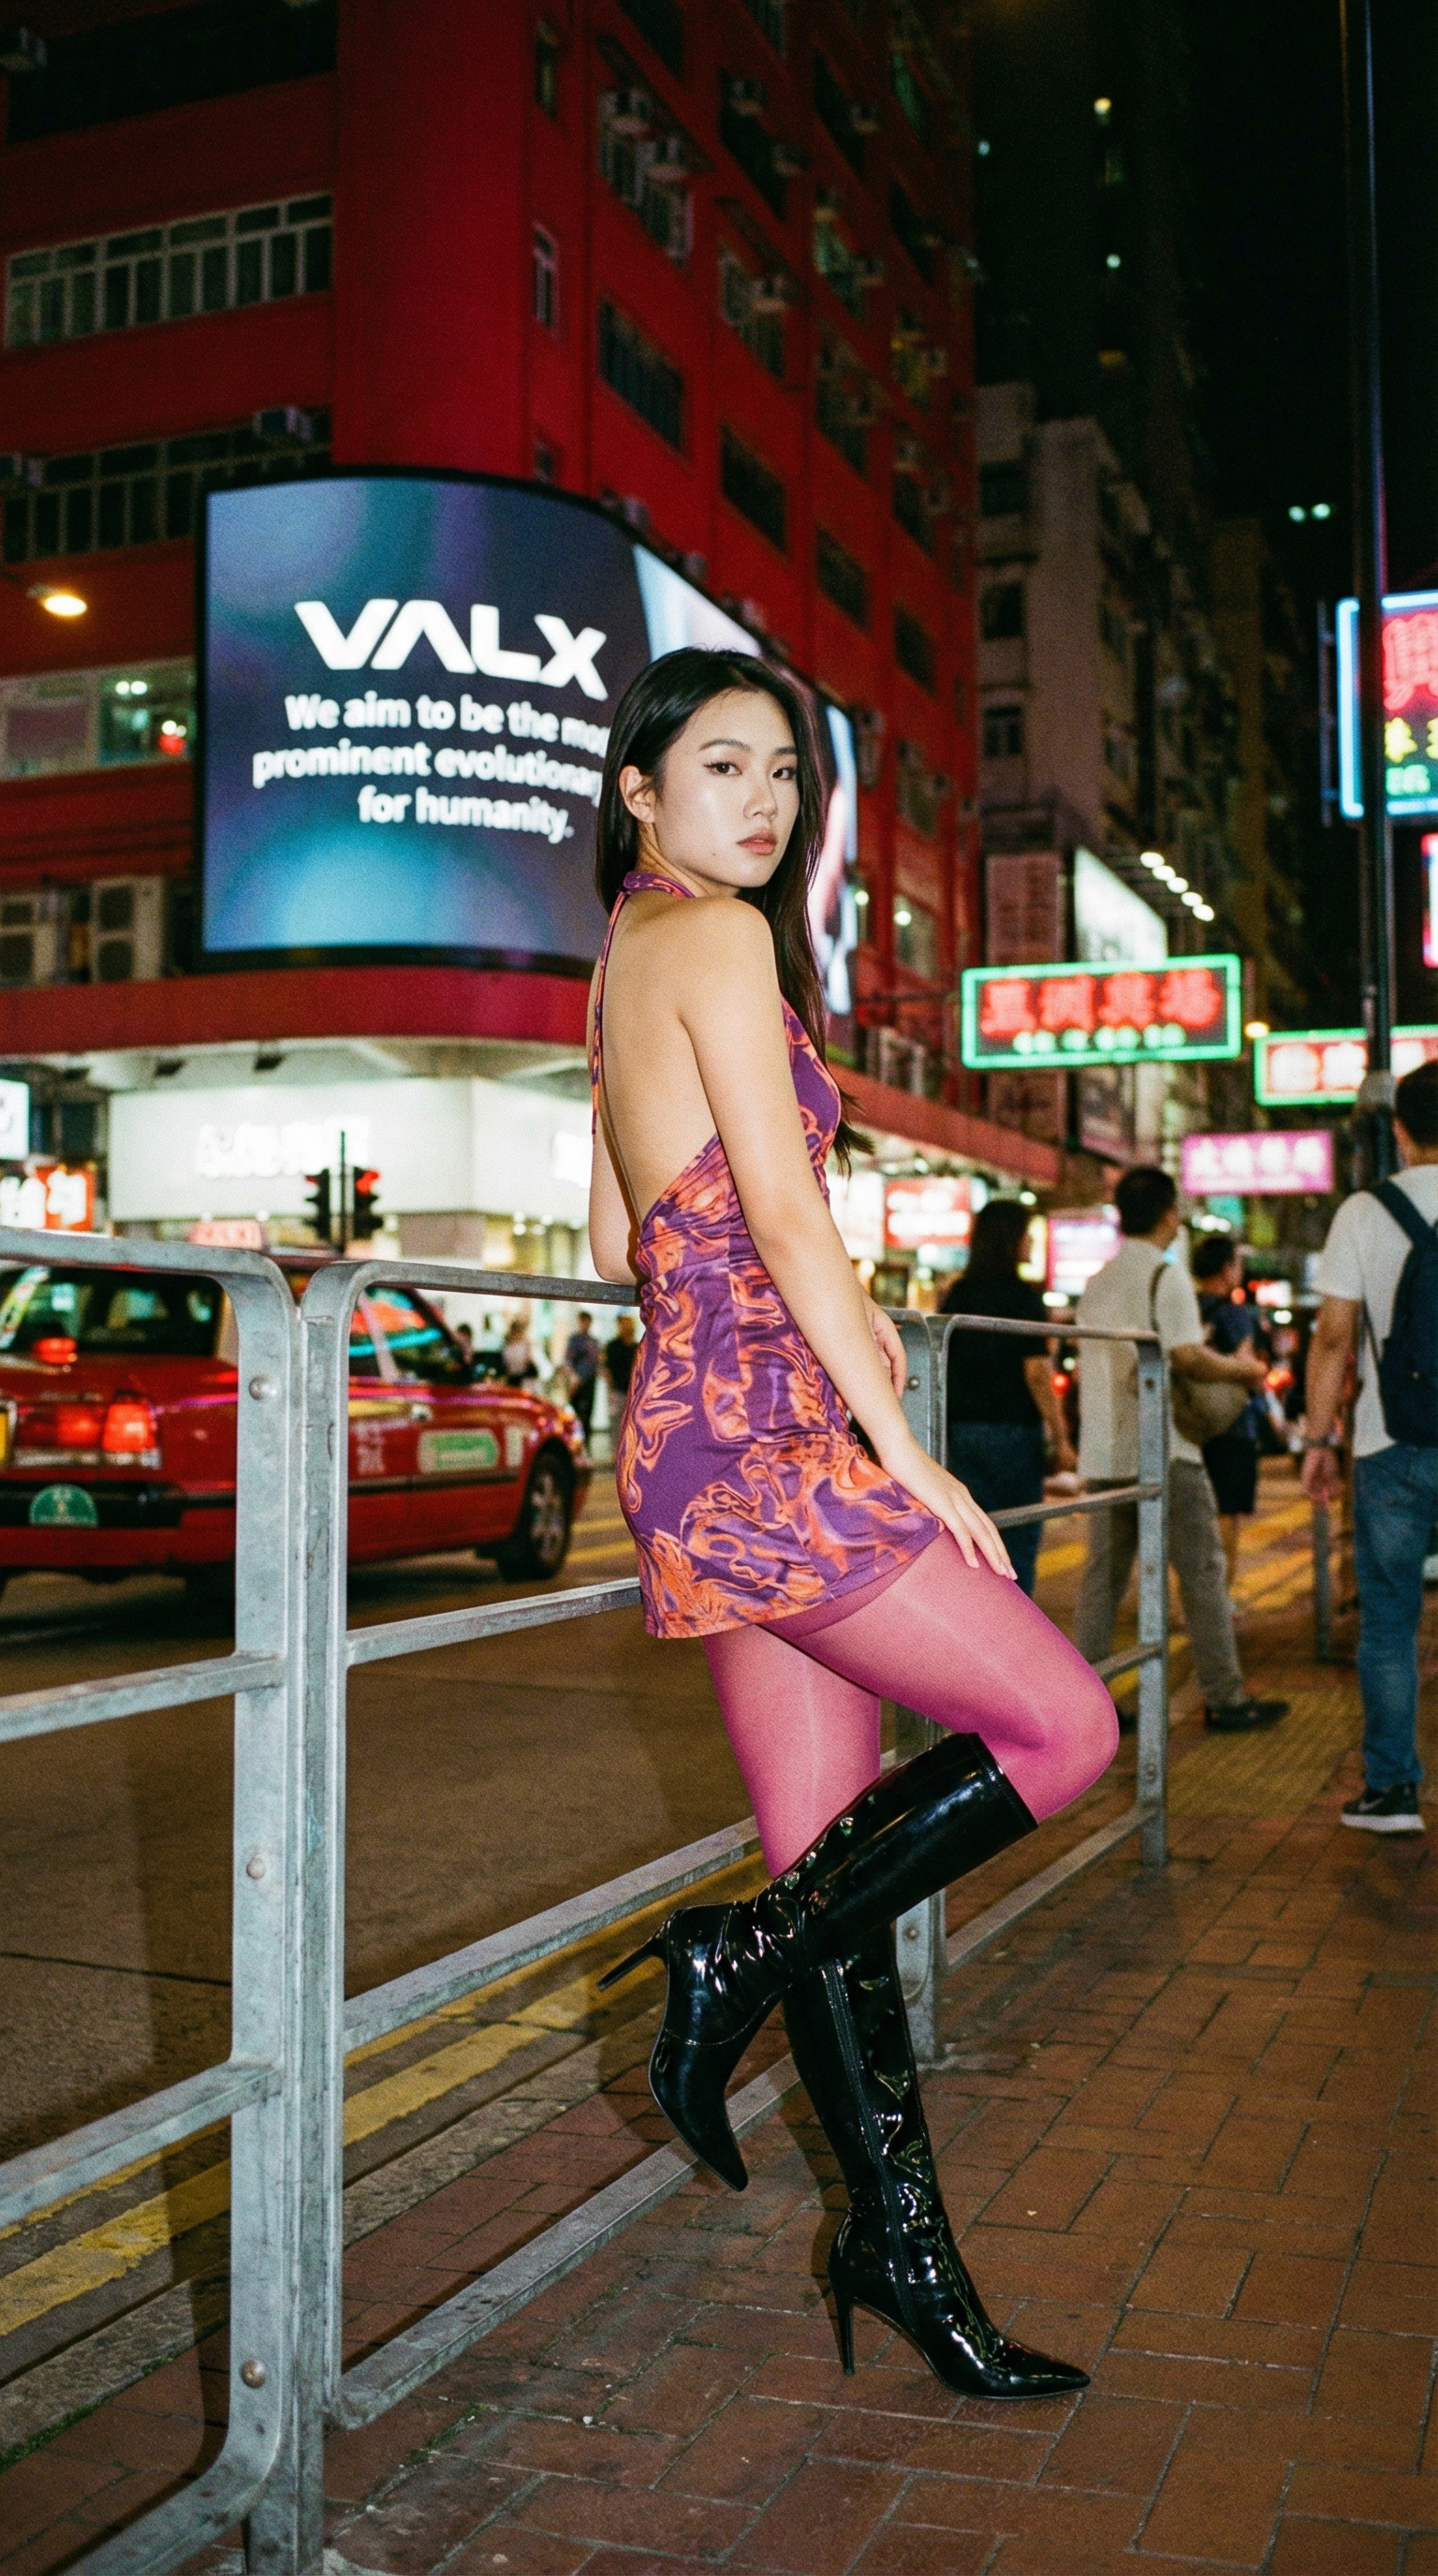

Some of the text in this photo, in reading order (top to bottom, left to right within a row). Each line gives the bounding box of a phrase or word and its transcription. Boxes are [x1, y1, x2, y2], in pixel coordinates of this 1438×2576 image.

[295, 598, 608, 701] VALX
[285, 694, 340, 730] We
[344, 691, 411, 728] aim
[416, 695, 456, 729] to
[460, 694, 505, 734] be
[506, 701, 559, 742] the
[253, 738, 431, 788] prominent
[358, 785, 575, 843] for humanity.
